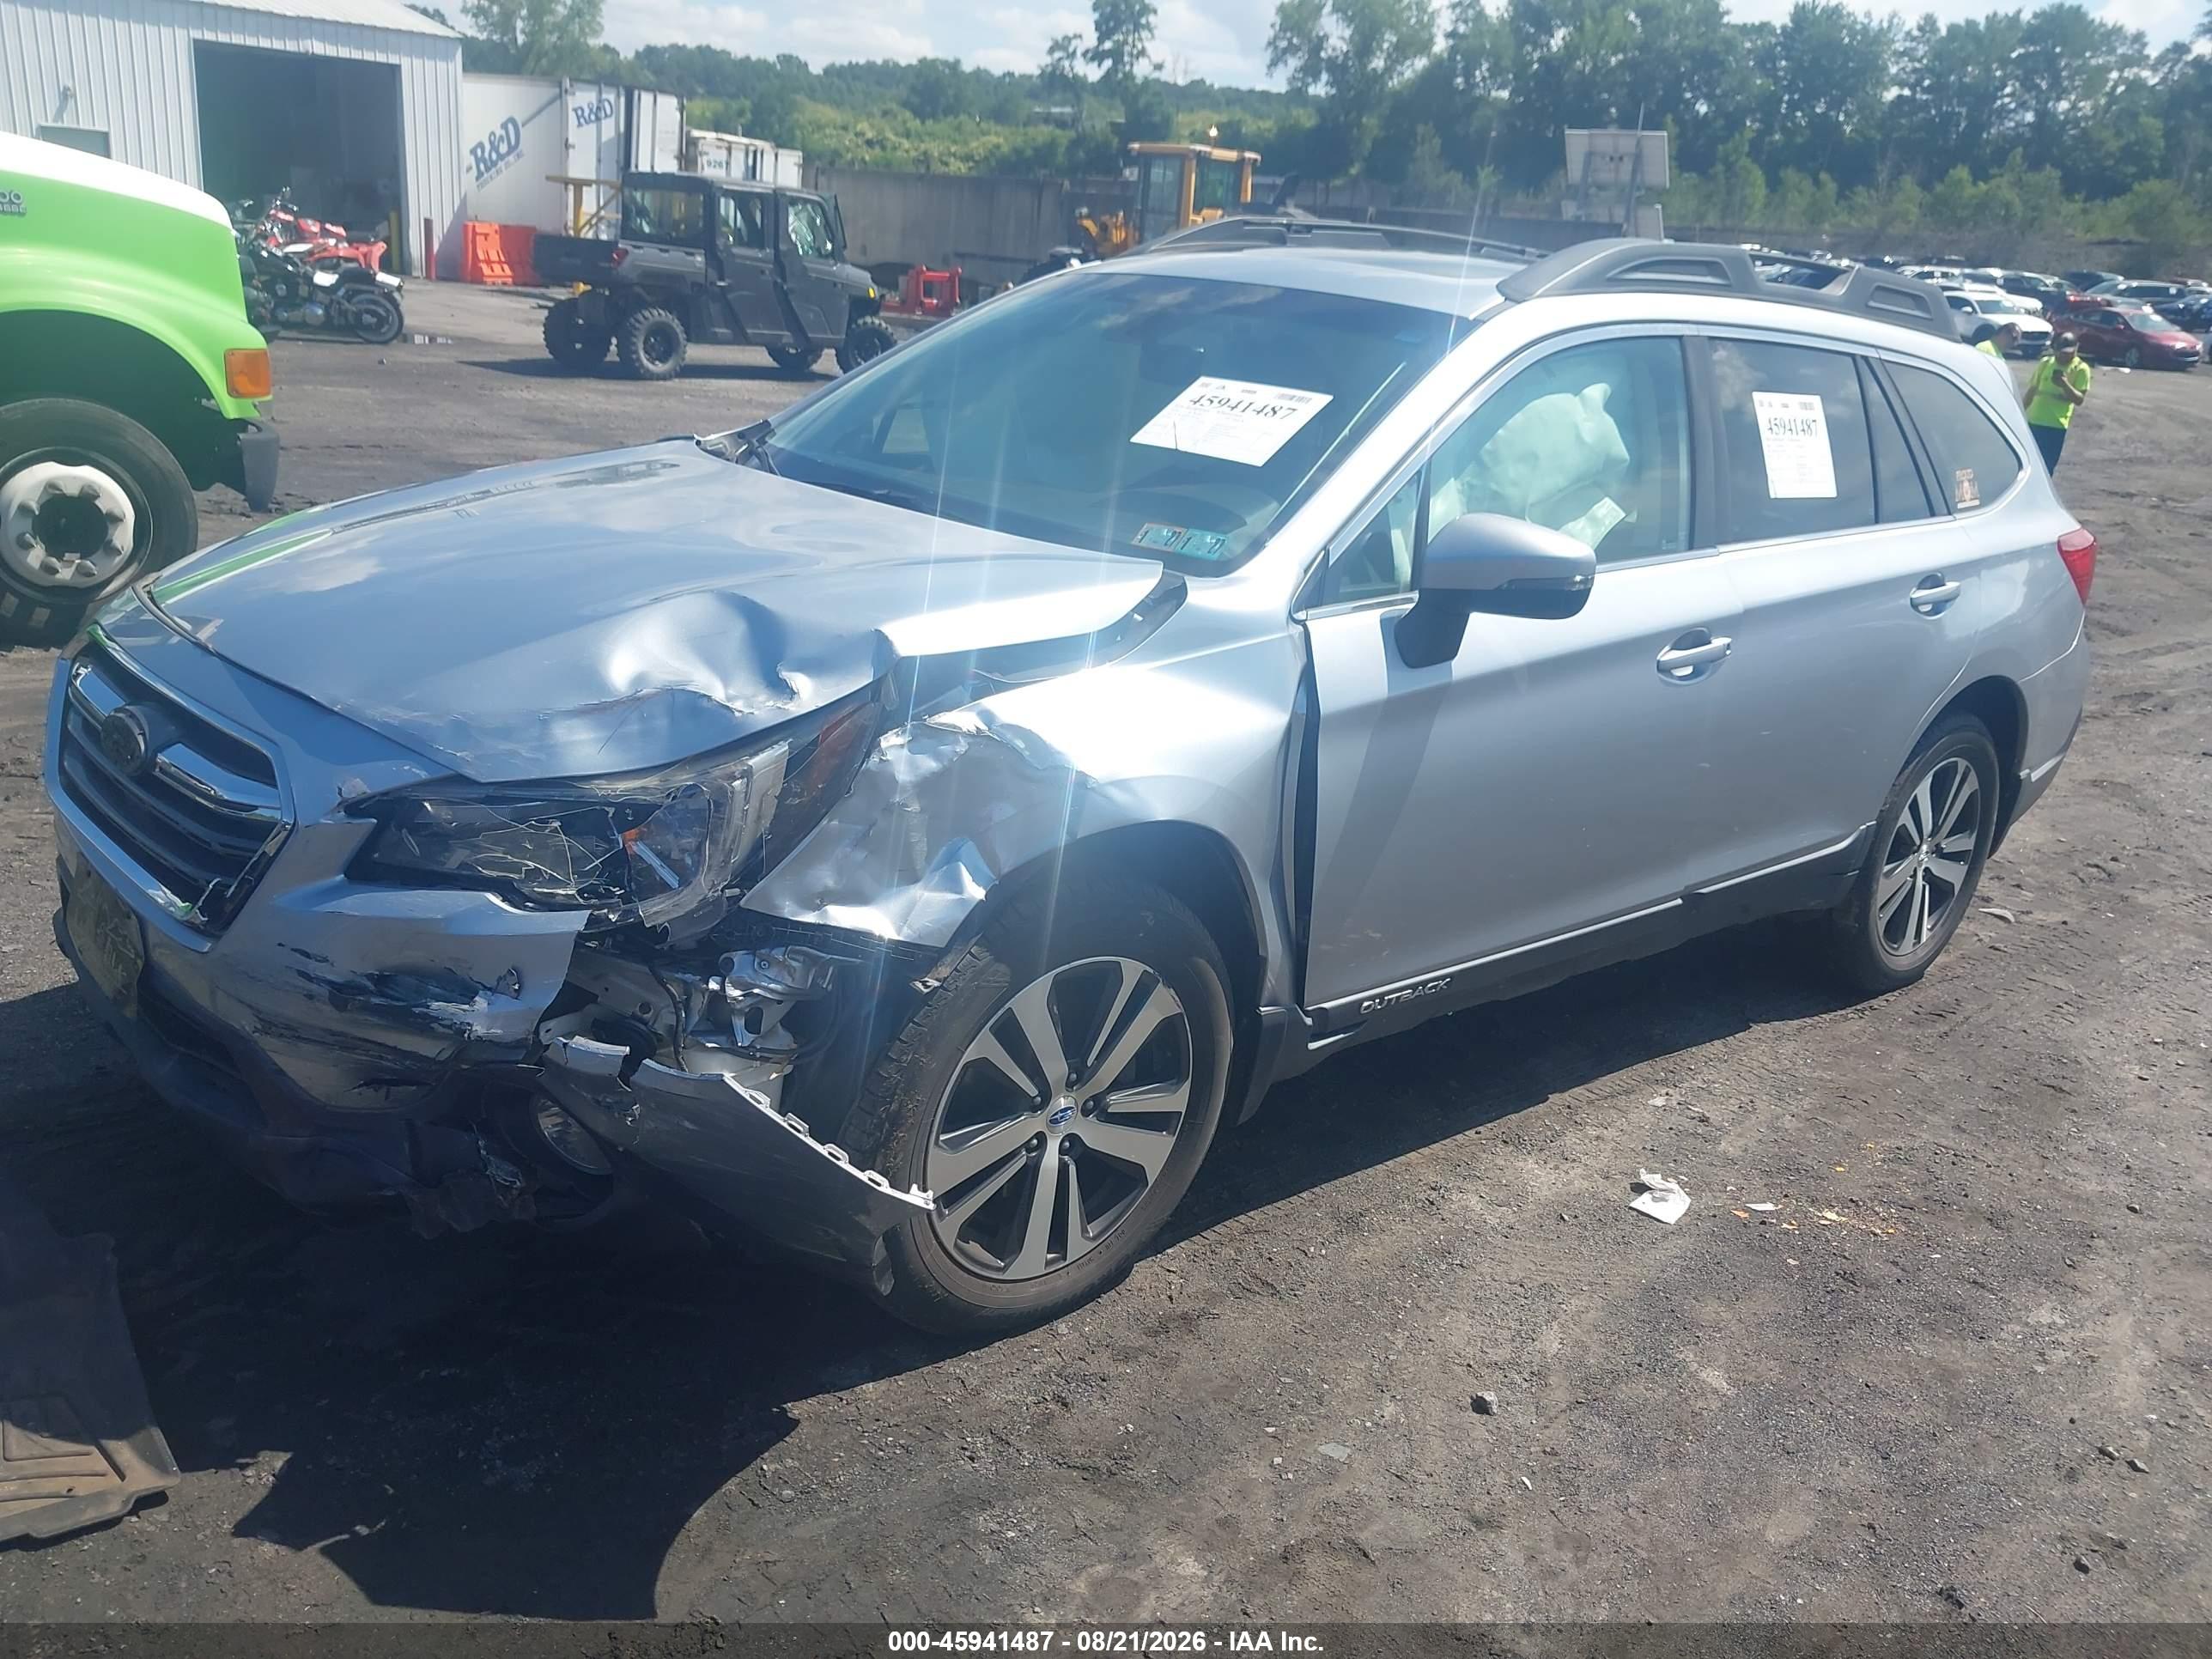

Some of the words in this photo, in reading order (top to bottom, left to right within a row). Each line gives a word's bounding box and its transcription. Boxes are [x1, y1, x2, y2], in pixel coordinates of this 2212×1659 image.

[572, 98, 614, 129] R&D
[470, 115, 522, 183] R&D
[1189, 393, 1298, 420] 45941487
[1767, 417, 1818, 438] 45941487
[1359, 977, 1451, 1014] OUTBACK
